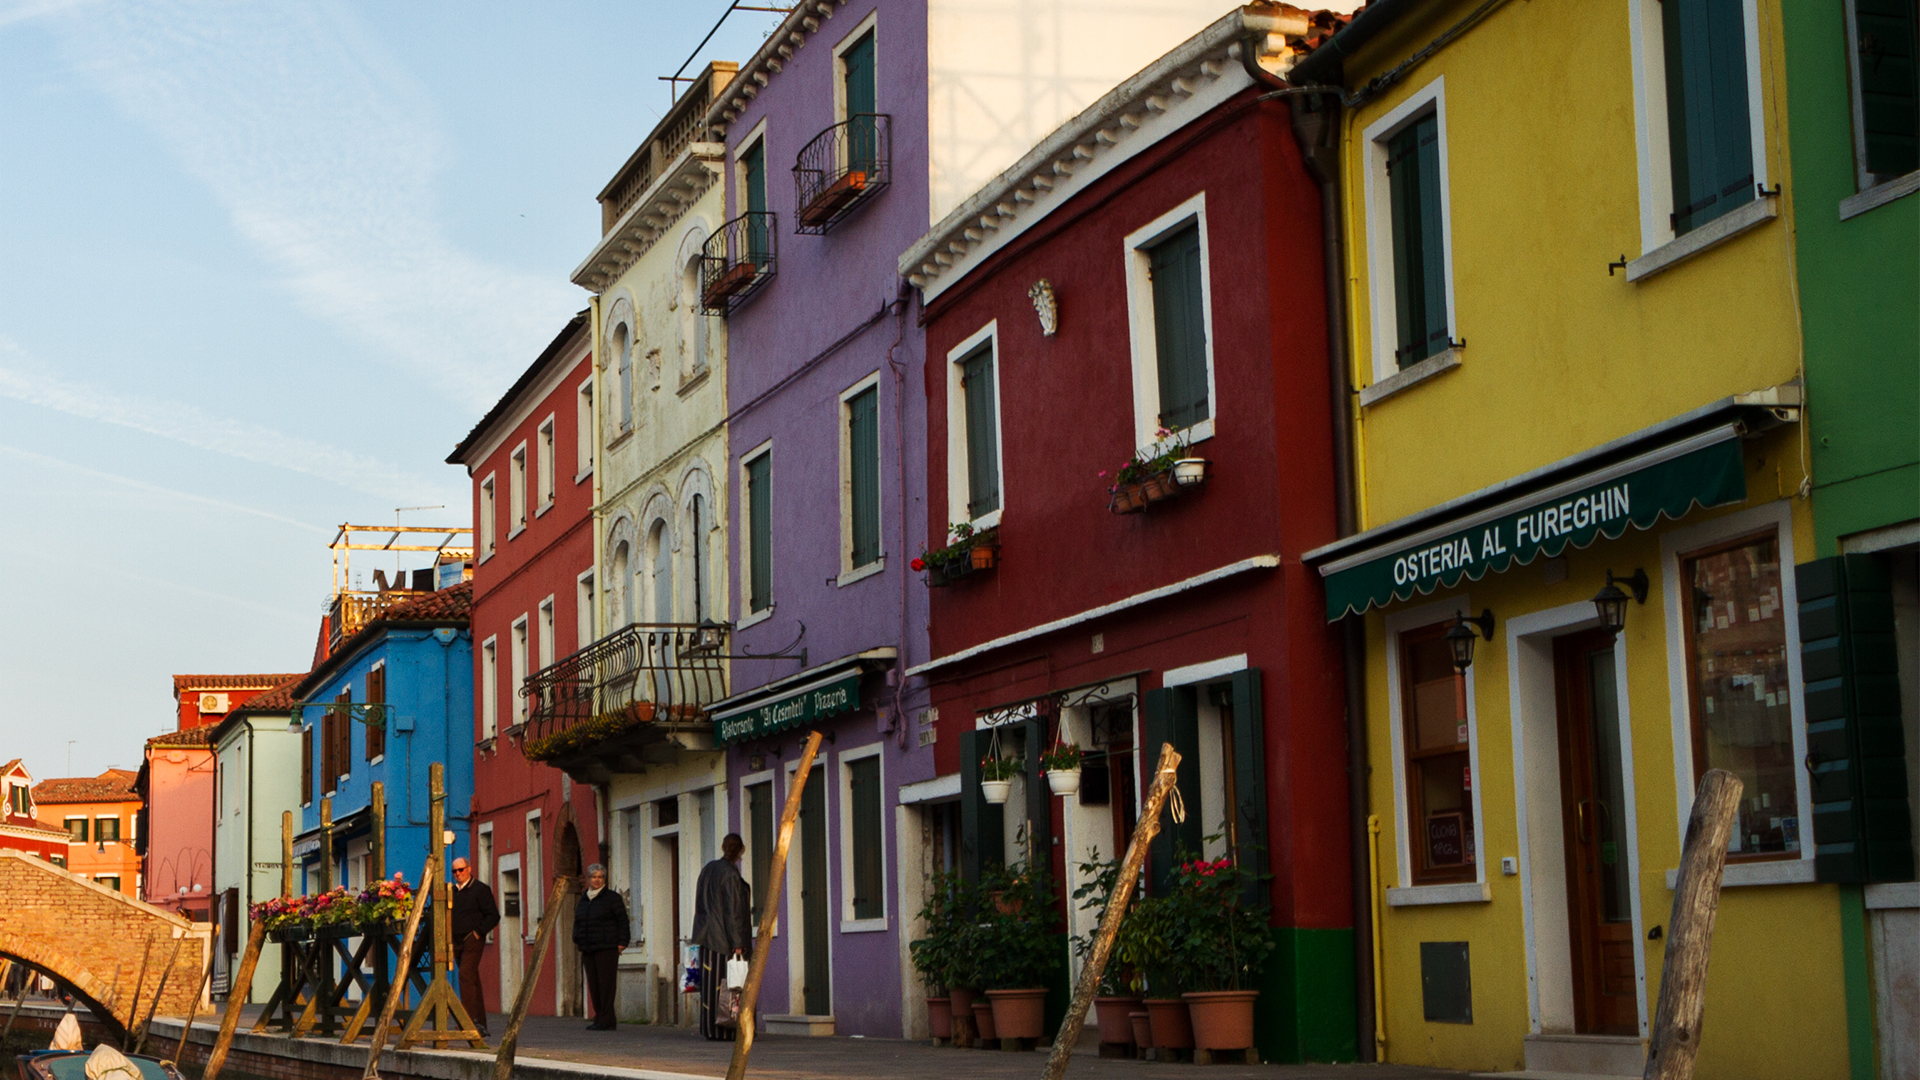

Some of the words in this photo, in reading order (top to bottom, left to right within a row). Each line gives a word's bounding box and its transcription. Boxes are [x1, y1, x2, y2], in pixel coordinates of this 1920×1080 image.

[1393, 536, 1473, 586] OSTERIA
[1481, 526, 1507, 560] AL
[1516, 483, 1630, 548] FUREGHIN
[721, 717, 753, 740] Ristorante
[814, 687, 847, 715] Pizzeria
